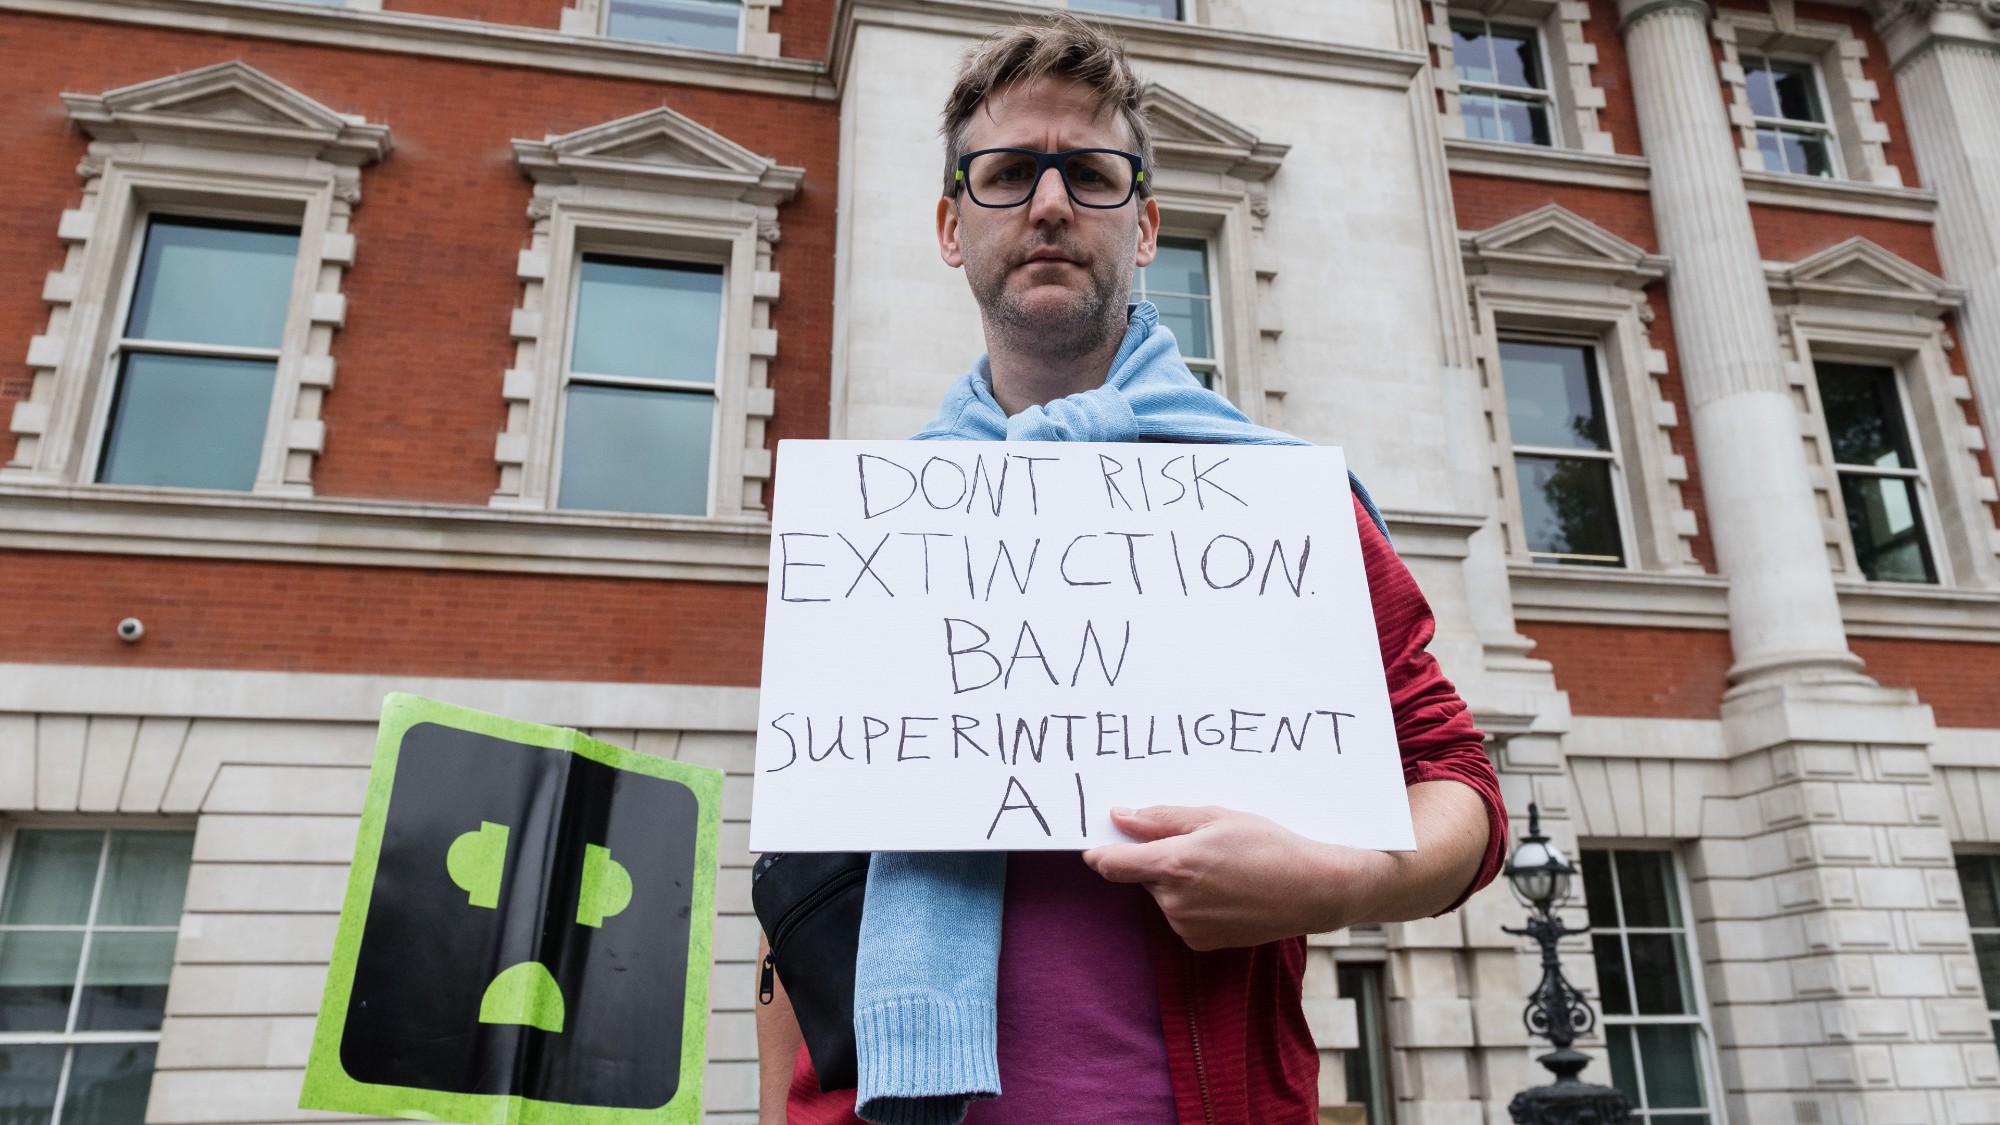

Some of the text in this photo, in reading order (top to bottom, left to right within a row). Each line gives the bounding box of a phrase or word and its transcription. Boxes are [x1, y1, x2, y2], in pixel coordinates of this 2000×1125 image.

[1099, 454, 1247, 511] RISK
[780, 531, 1315, 602] EXTINCTION.
[944, 618, 1129, 694] BAN
[766, 709, 1355, 772] SUPERINTELLIGENT
[987, 773, 1086, 839] AI
